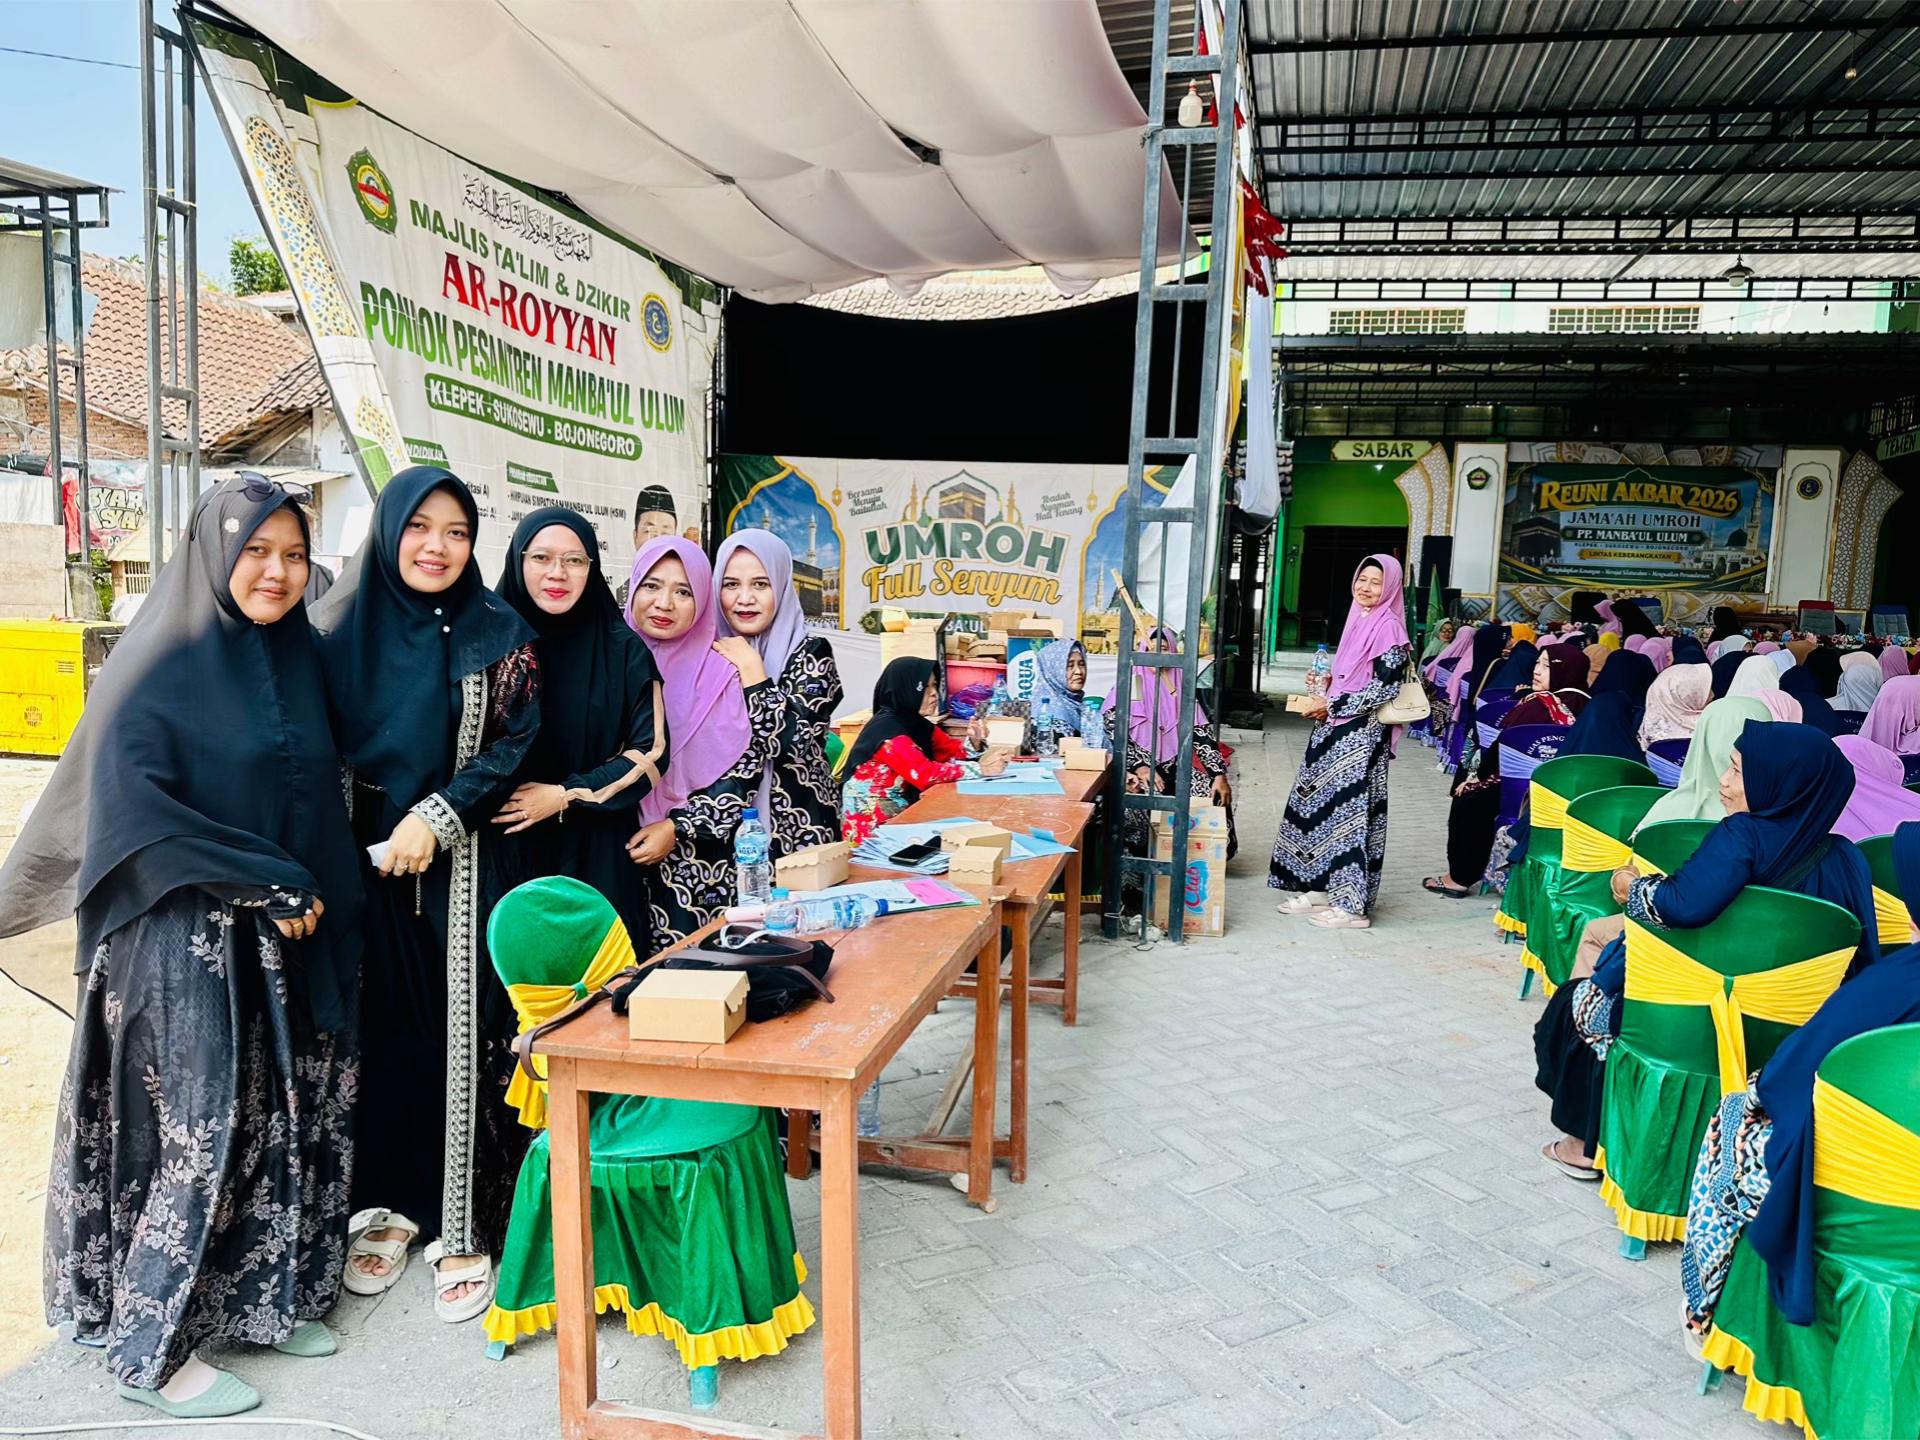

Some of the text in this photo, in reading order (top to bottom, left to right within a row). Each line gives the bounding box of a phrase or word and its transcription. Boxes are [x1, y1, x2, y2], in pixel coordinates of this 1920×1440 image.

[410, 199, 631, 322] MAJLIS TA'LIM & DZIKIR
[442, 251, 618, 365] AR-ROYYAN
[453, 319, 542, 402] PESANTREN
[547, 359, 634, 425] MANBA'UL
[429, 379, 485, 416] KLEPEK
[493, 399, 544, 437] SUKOSEWU
[554, 420, 635, 456] BOJONEGORO
[1352, 442, 1414, 458] SABAR
[847, 486, 883, 500] Bersama
[1612, 482, 1685, 506] AKBAR
[1687, 486, 1738, 512] 2026
[1567, 511, 1702, 528] JAMA'AH UMROH
[1576, 529, 1688, 543] PP. MANBA'UL ULUM
[864, 523, 1067, 574] UMROH
[862, 559, 1063, 607] Full Senyum
[1018, 658, 1034, 699] AQUA
[1184, 865, 1201, 908] Club
